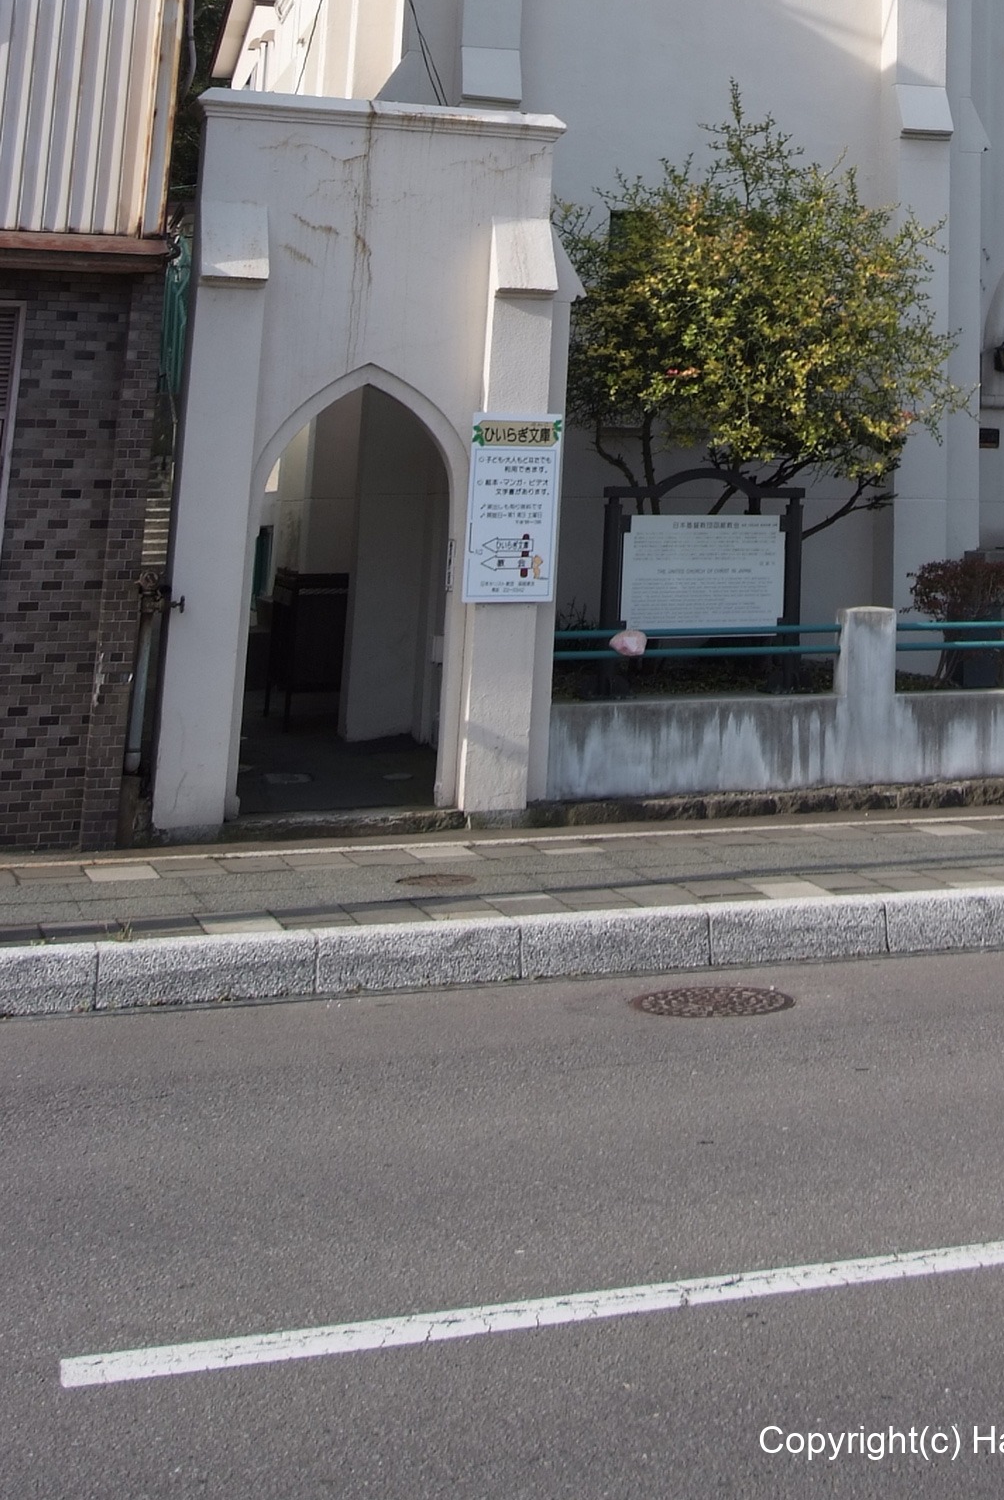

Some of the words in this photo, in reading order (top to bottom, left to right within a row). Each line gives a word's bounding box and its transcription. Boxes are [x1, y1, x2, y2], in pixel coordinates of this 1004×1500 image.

[484, 427, 551, 443] ひいらぎ文庫
[496, 541, 529, 550] ひいらぎ文庫
